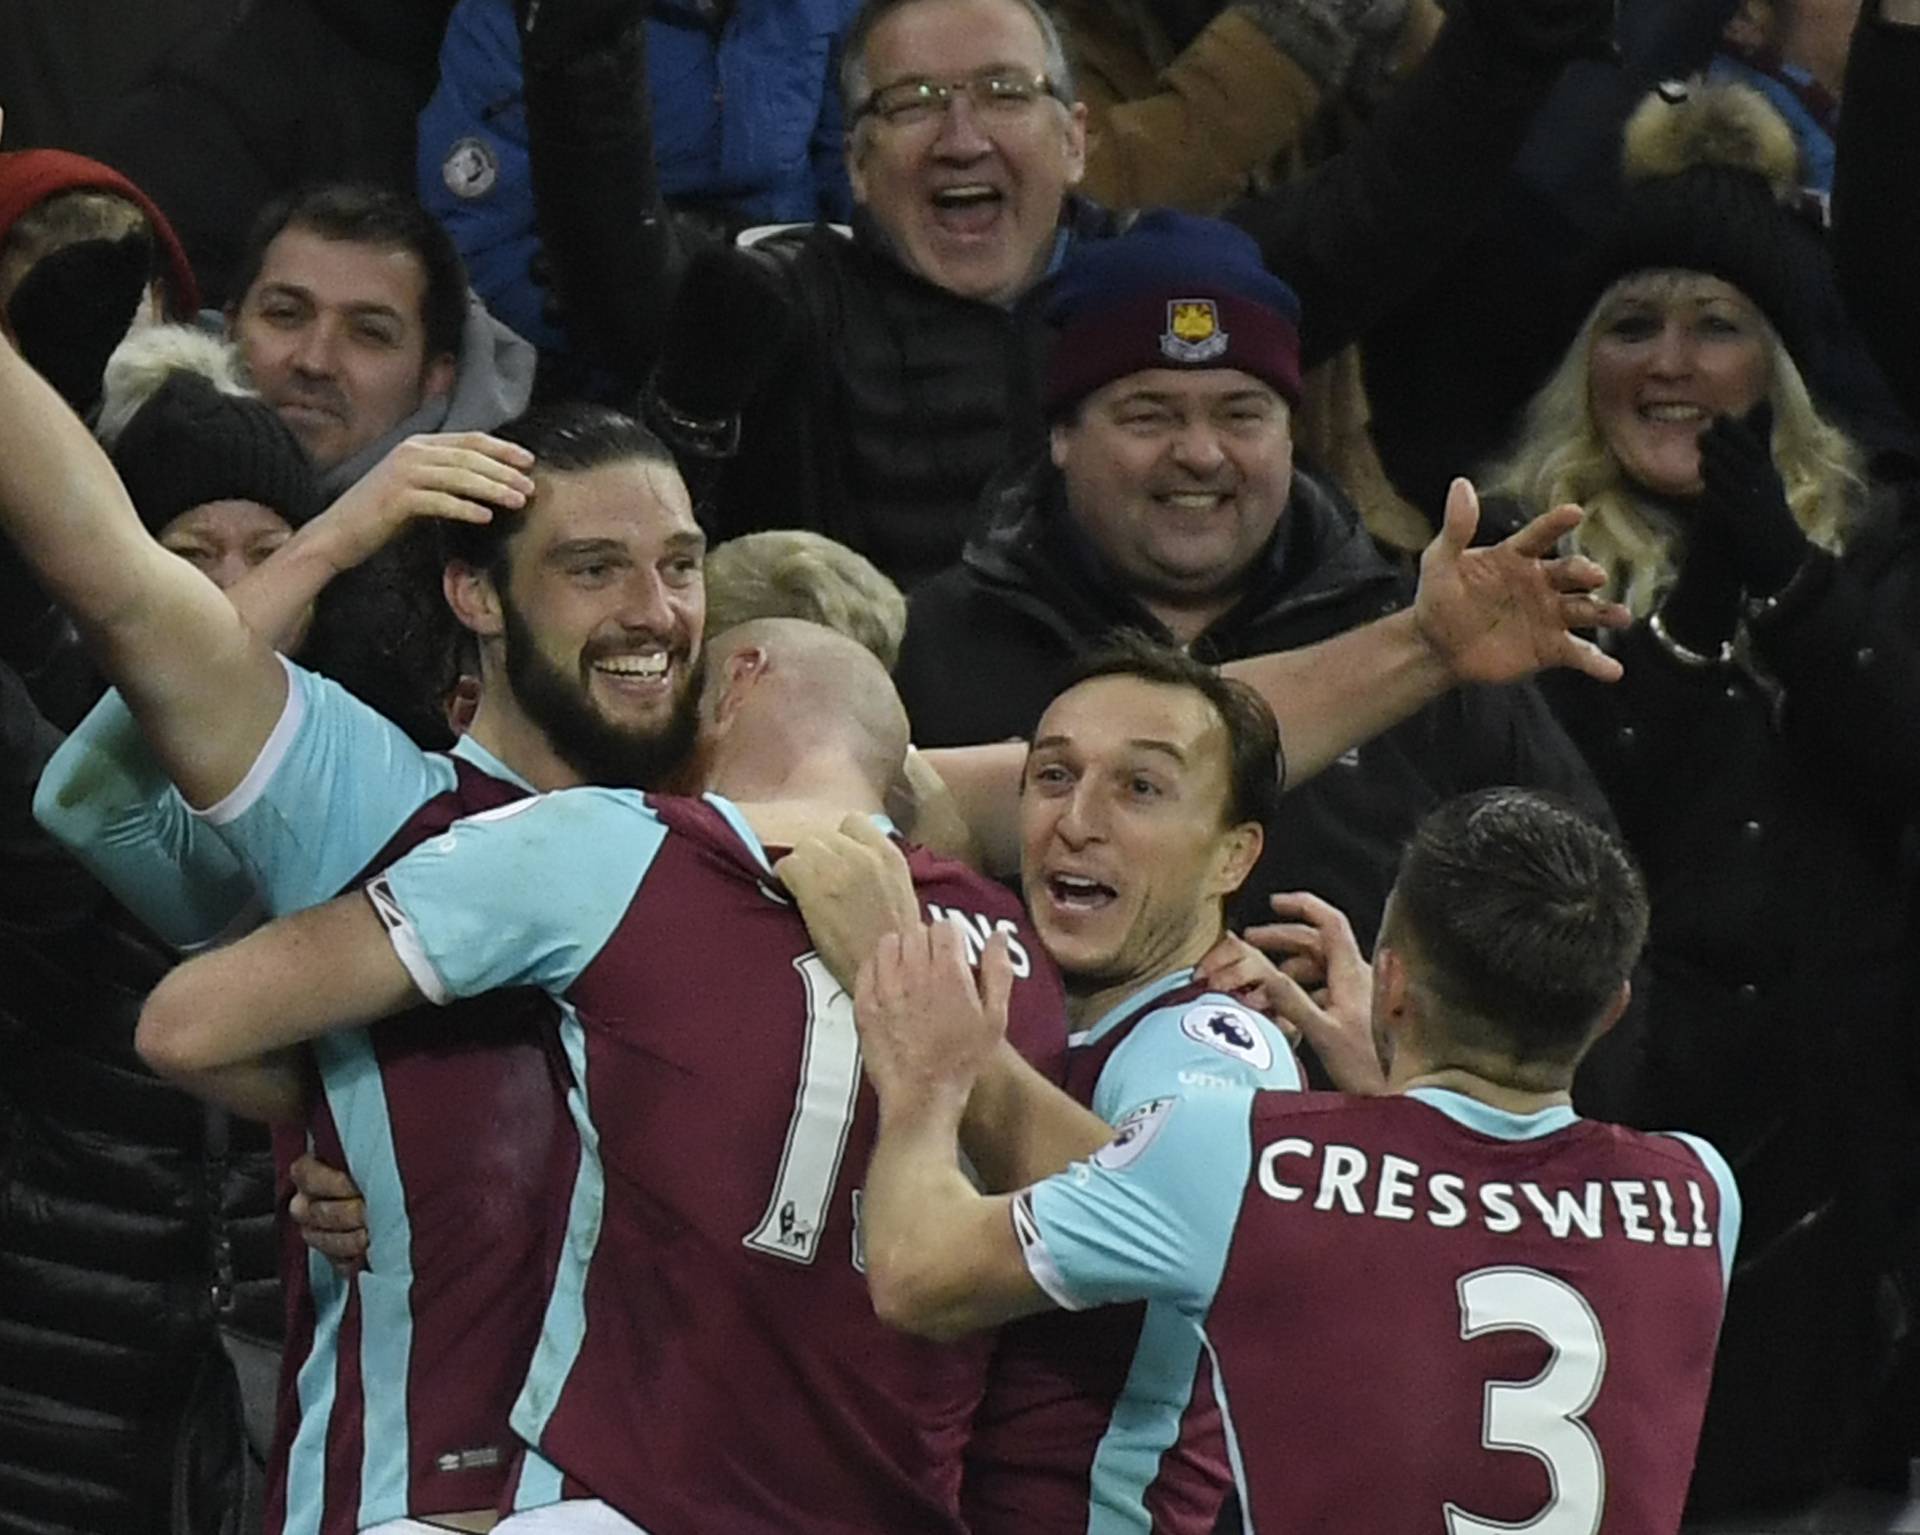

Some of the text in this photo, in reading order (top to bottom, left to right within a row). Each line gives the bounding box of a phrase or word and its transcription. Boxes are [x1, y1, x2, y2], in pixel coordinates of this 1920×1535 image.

[743, 951, 866, 1273] 1
[1257, 1138, 1713, 1247] CRESSWELL
[1443, 1265, 1607, 1535] 3
